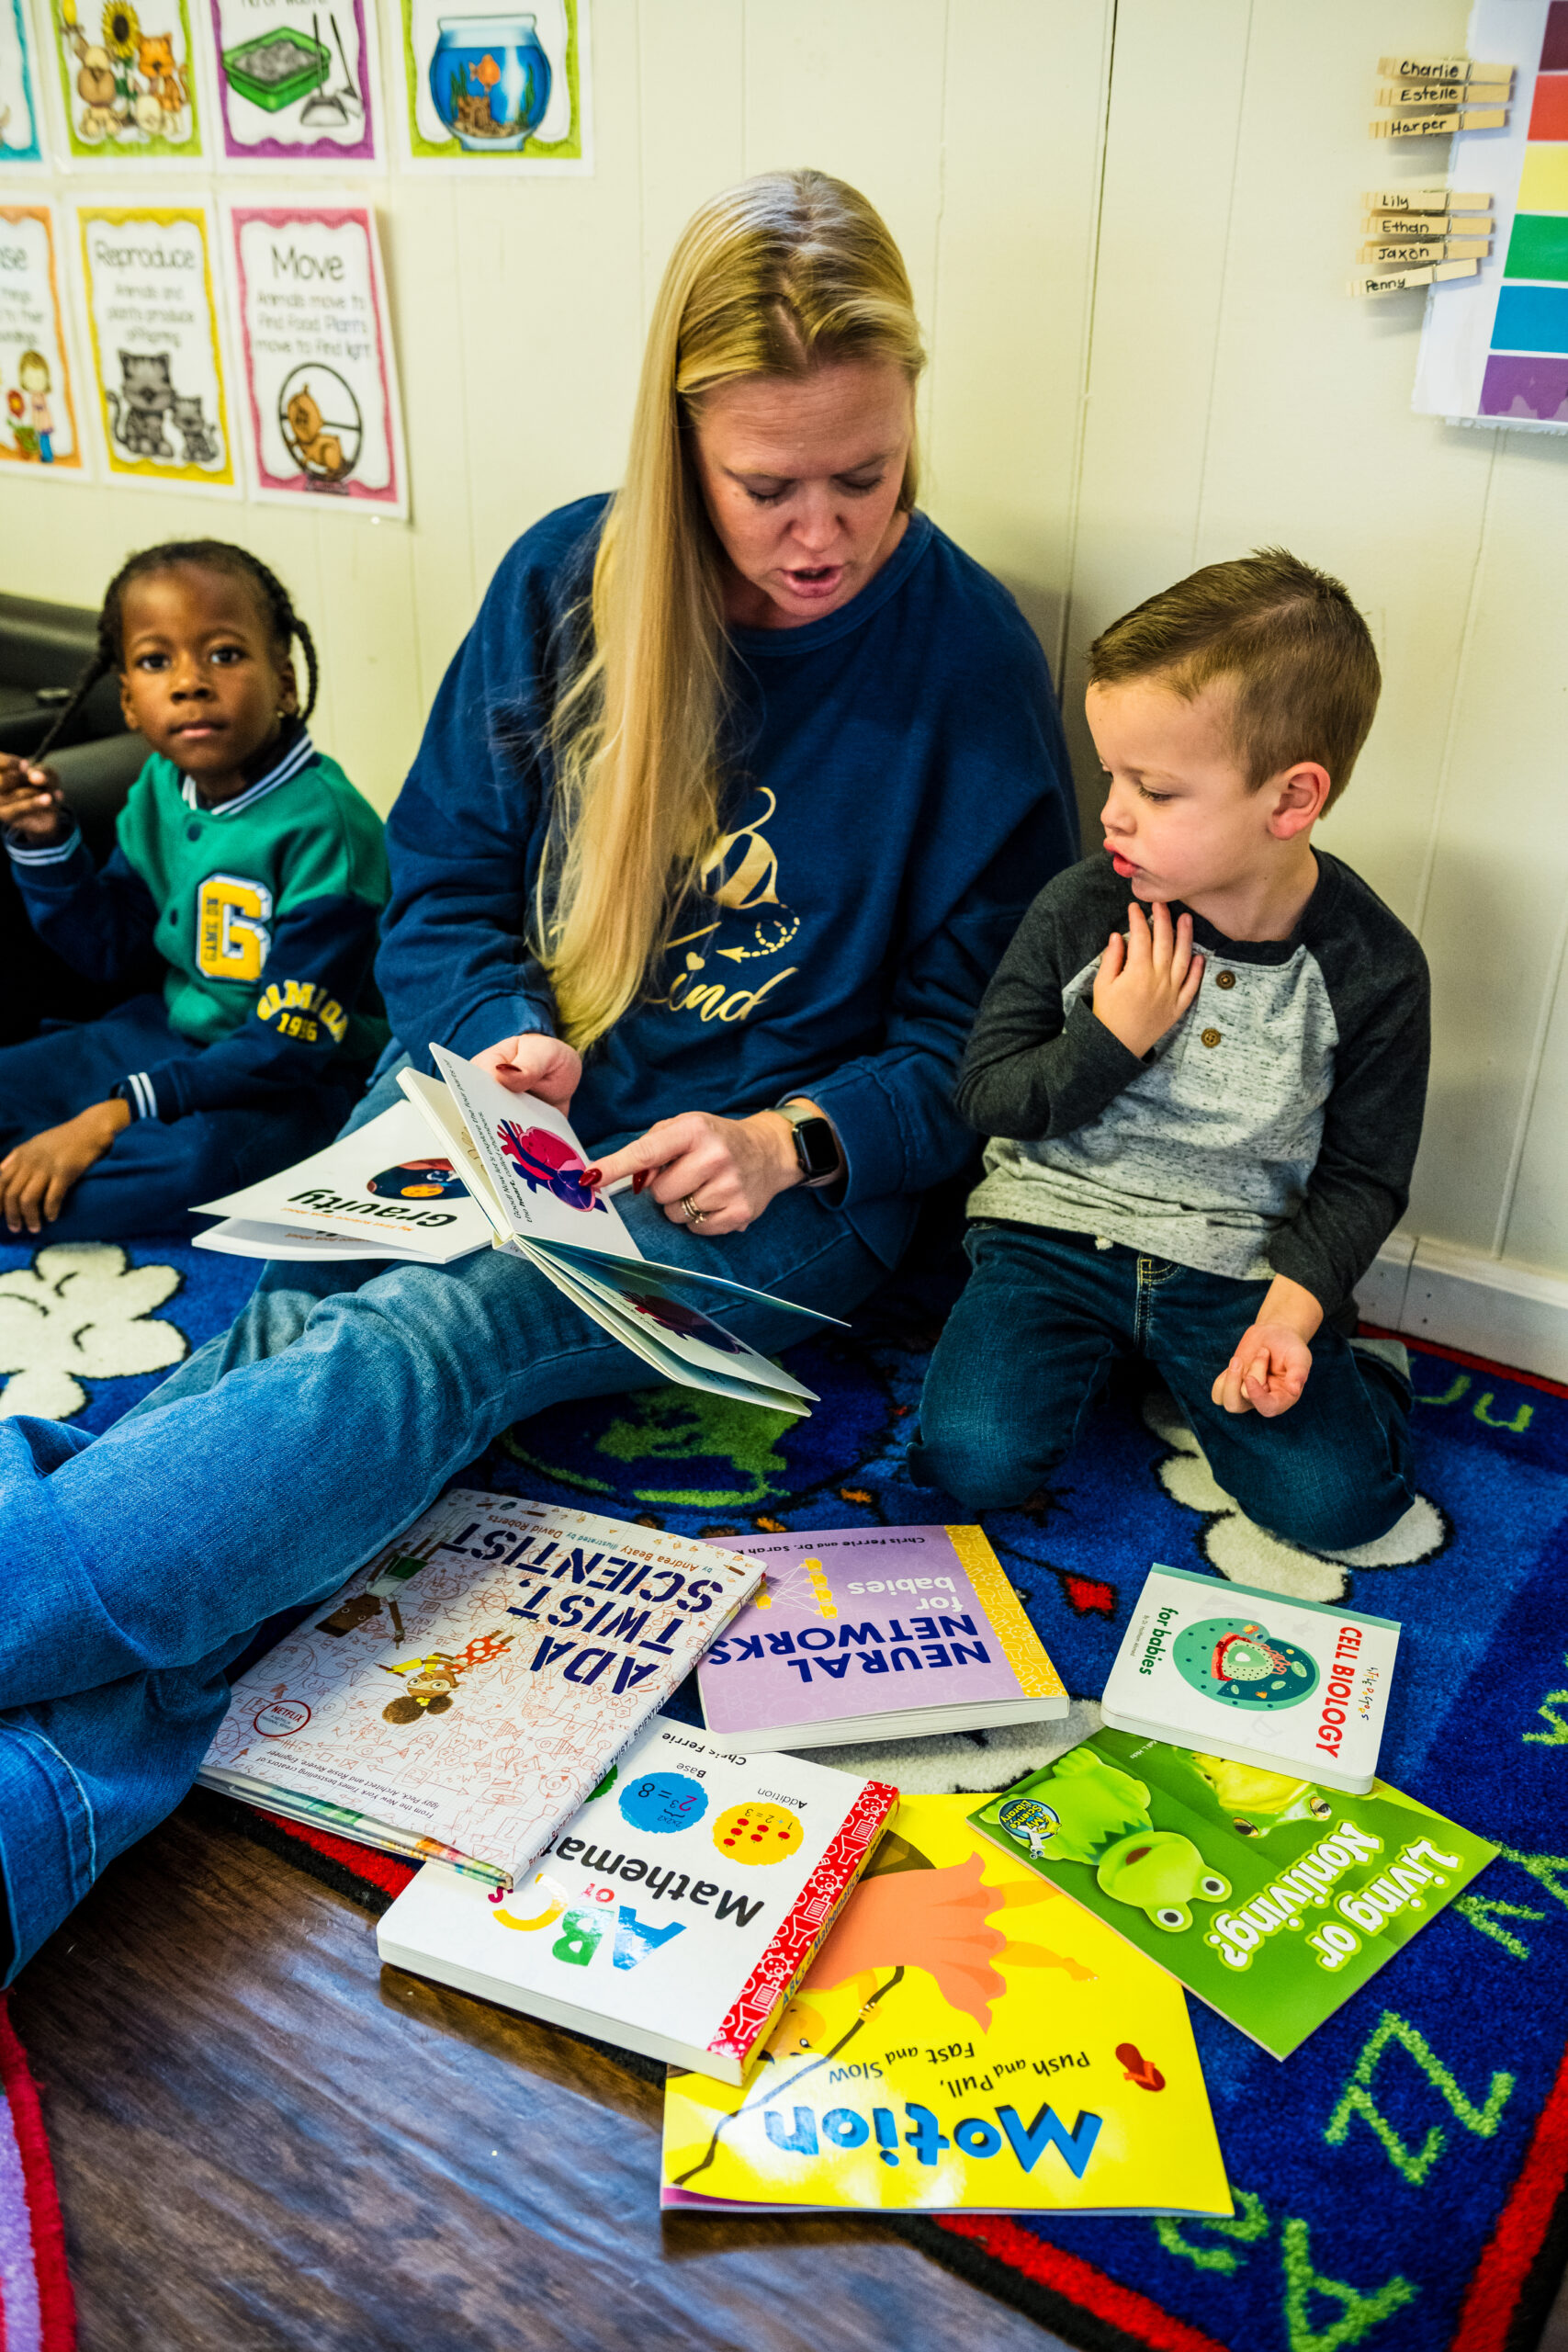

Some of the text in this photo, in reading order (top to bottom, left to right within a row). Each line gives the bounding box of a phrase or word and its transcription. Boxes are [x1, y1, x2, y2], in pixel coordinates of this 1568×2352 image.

[1400, 61, 1460, 79] Charlie
[1400, 85, 1458, 101] Estelle
[1391, 119, 1448, 136] Harper
[1382, 194, 1409, 210] Lily
[1382, 220, 1430, 234] Ethan
[95, 240, 197, 274] Reproduce
[271, 244, 345, 281] Move
[1378, 247, 1429, 262] Jaxon
[1366, 277, 1406, 293] Penny
[197, 873, 274, 983] G
[287, 1189, 458, 1227] Gravity
[487, 1515, 528, 1532] Roberts
[529, 1523, 563, 1540] David
[576, 1534, 620, 1550] illustrated
[748, 1545, 791, 1555] Sarah
[793, 1543, 814, 1551] Dr.
[841, 1538, 886, 1547] Ferrie
[619, 1544, 654, 1563] Beaty
[439, 1522, 724, 1613] SCIENTIST
[656, 1555, 700, 1573] Andrea
[702, 1566, 714, 1574] by
[846, 1577, 956, 1595] babies
[916, 1596, 964, 1613] for
[505, 1578, 684, 1655] TWIST,
[707, 1614, 979, 1665] NETWORKS
[1138, 1607, 1179, 1676] for babies
[530, 1635, 660, 1695] ADA
[787, 1640, 992, 1683] NEURAL
[1315, 1626, 1363, 1759] CELL BIOLOGY
[270, 1705, 306, 1724] NETFLIX
[633, 1696, 666, 1740] SCIENTIST
[661, 1732, 706, 1753] Ferrie
[265, 1749, 299, 1764] Engineer
[265, 1758, 297, 1773] creators
[299, 1759, 326, 1773] Revere,
[326, 1767, 349, 1781] Rosie
[676, 1761, 707, 1779] Base
[297, 1768, 337, 1788] bestselling
[349, 1774, 365, 1784] and
[336, 1781, 360, 1795] Times
[360, 1791, 378, 1801] York
[364, 1778, 400, 1797] Architect
[380, 1795, 400, 1807] New
[401, 1791, 422, 1804] Peck,
[757, 1786, 808, 1810] Addition
[402, 1803, 414, 1812] the
[419, 1808, 435, 1819] From
[999, 1799, 1032, 1824] Library
[1009, 1804, 1043, 1829] Science
[1025, 1816, 1044, 1829] My
[1207, 1821, 1381, 1970] Nonliving?
[1310, 1838, 1461, 1970] Living or
[813, 1870, 861, 1951] Mathematics
[829, 2041, 976, 2086] Fast and Slow
[939, 2051, 1091, 2099] Push and Pull,
[763, 2101, 1104, 2180] Motion
